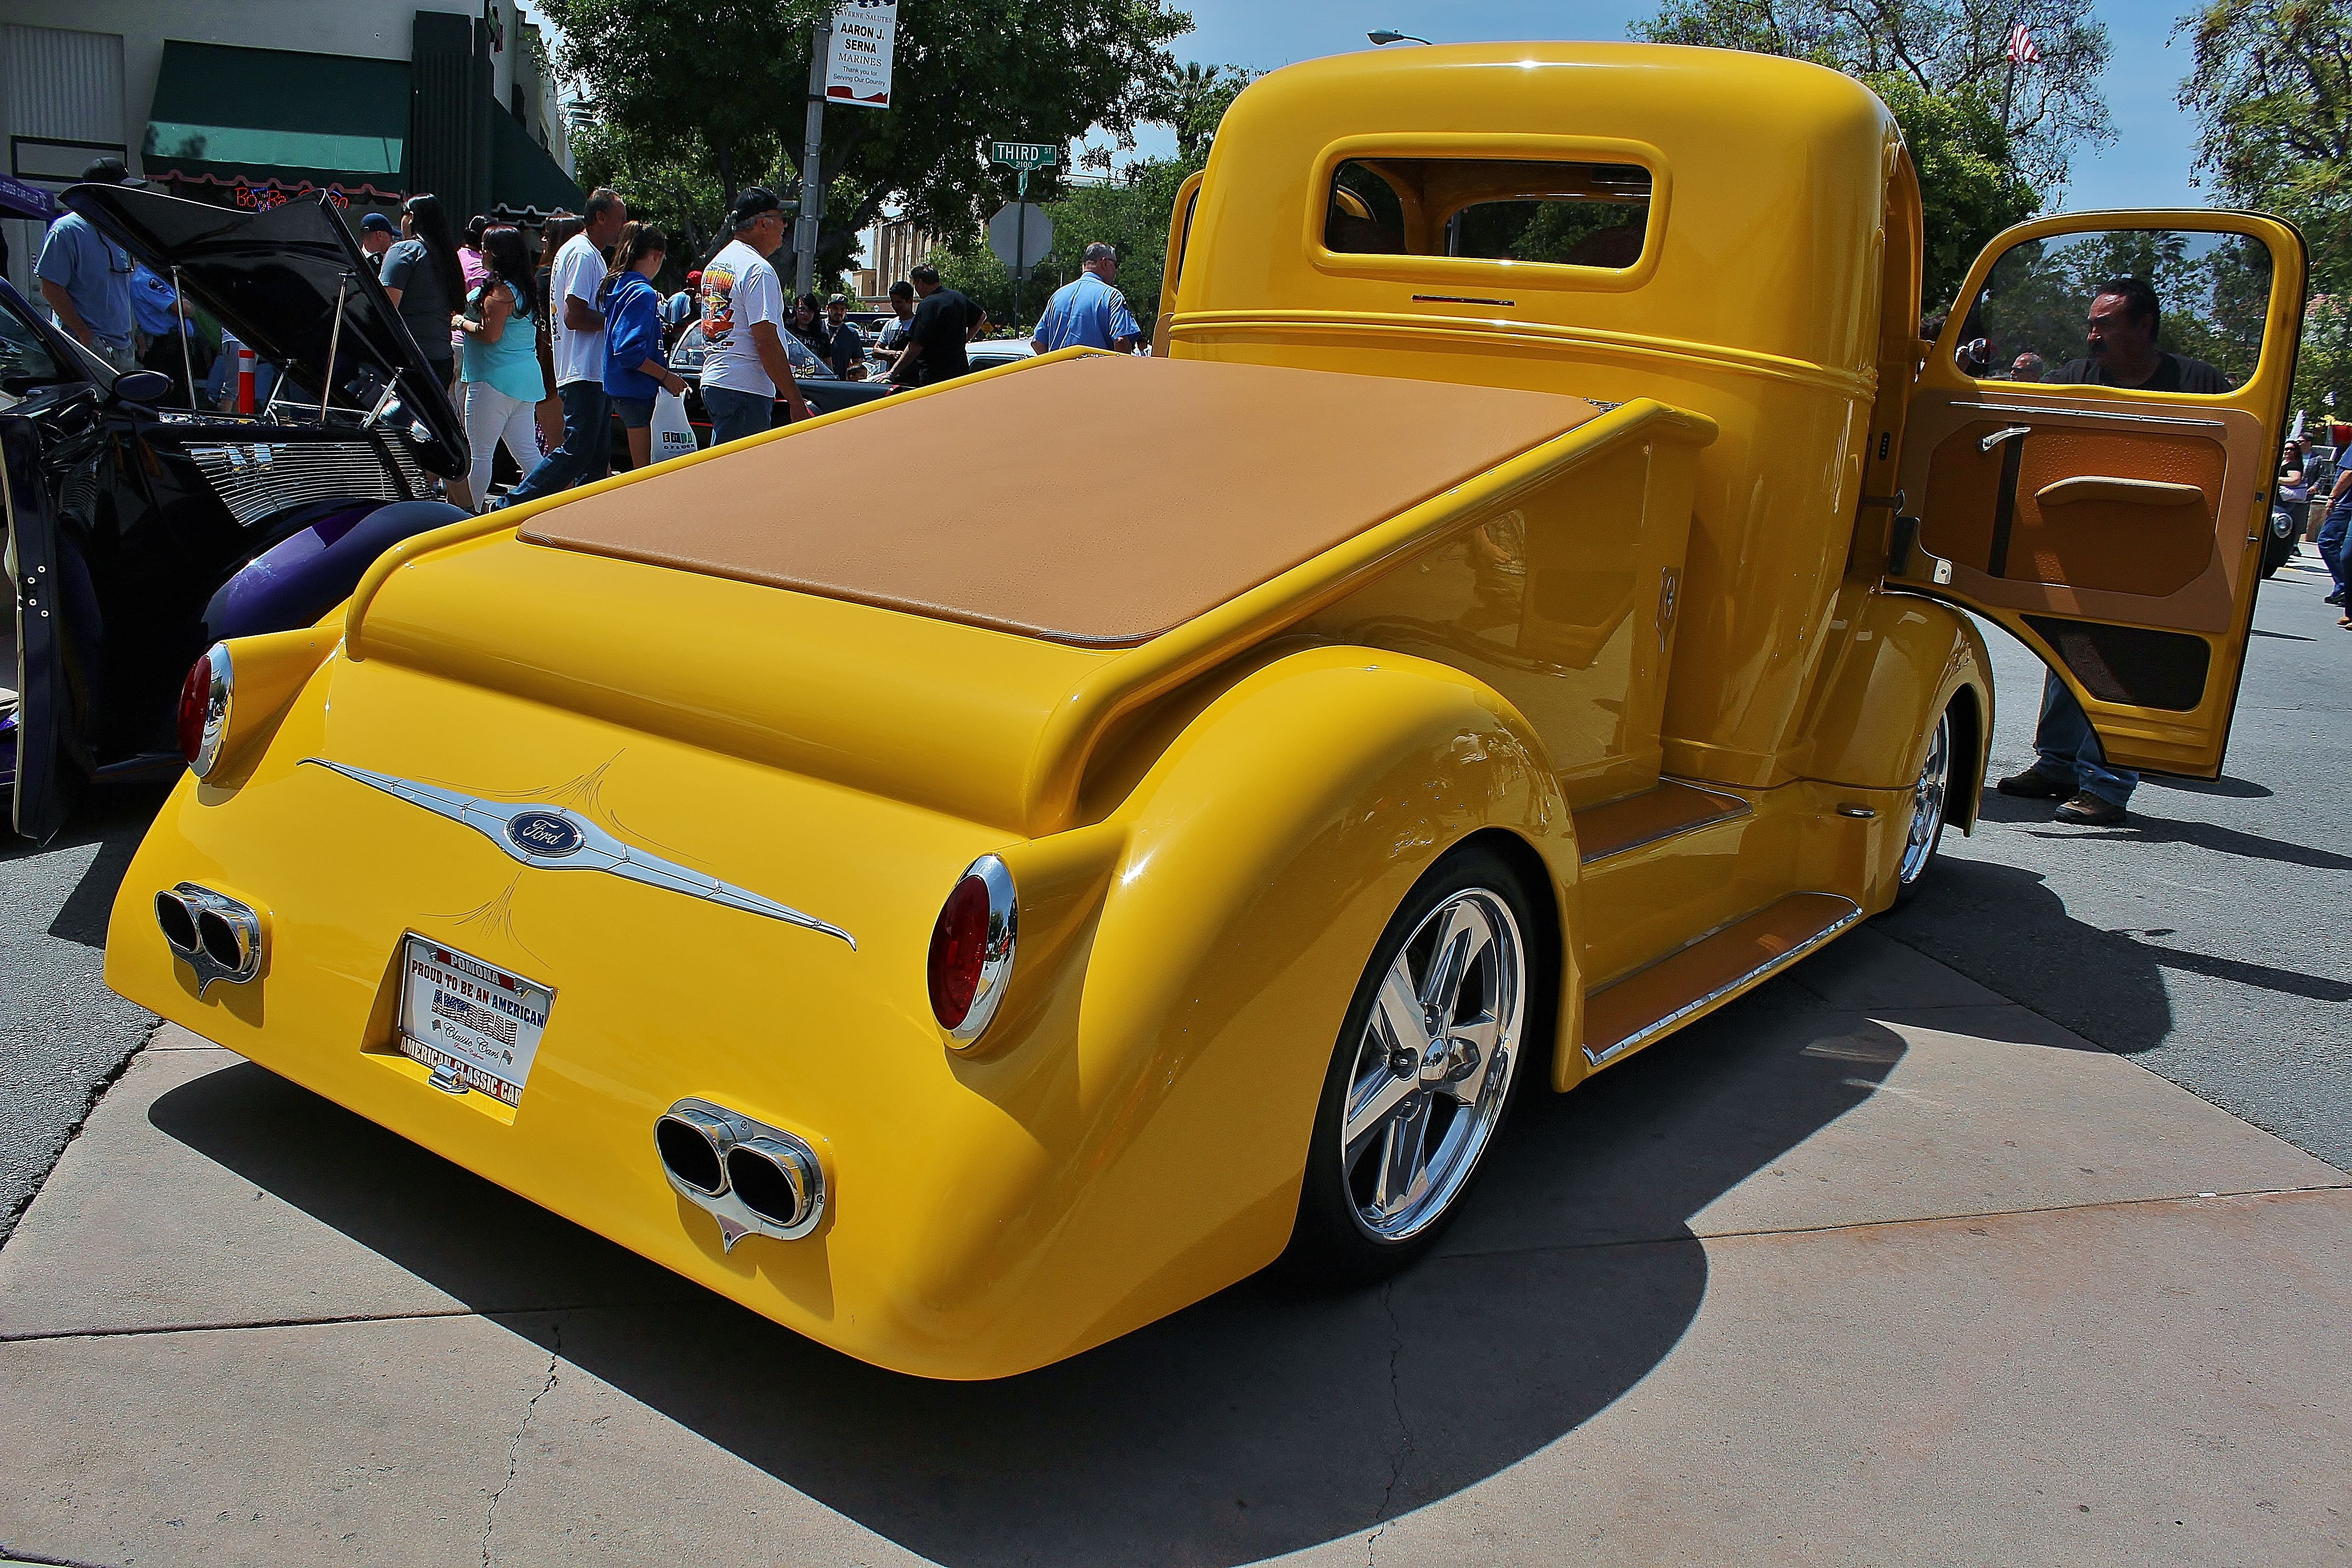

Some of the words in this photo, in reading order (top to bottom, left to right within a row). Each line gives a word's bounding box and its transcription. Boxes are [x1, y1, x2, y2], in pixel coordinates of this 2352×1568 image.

[840, 22, 874, 38] AARON
[876, 29, 884, 40] J.
[845, 39, 877, 54] SERNA
[838, 53, 882, 67] MARINES
[833, 74, 853, 82] Serving
[865, 78, 886, 87] Country
[997, 145, 1039, 161] THIRD
[522, 819, 565, 845] Ford
[450, 954, 500, 985] POMONA
[412, 960, 443, 984] PROUD
[446, 973, 458, 991] TO
[461, 980, 474, 998] BE
[475, 987, 490, 1005] AN
[492, 994, 545, 1029] AMERICAN
[431, 989, 518, 1048] AMERICAN
[400, 1036, 451, 1066] AMERICAN
[444, 1022, 473, 1046] Classic
[477, 1036, 500, 1059] Cars
